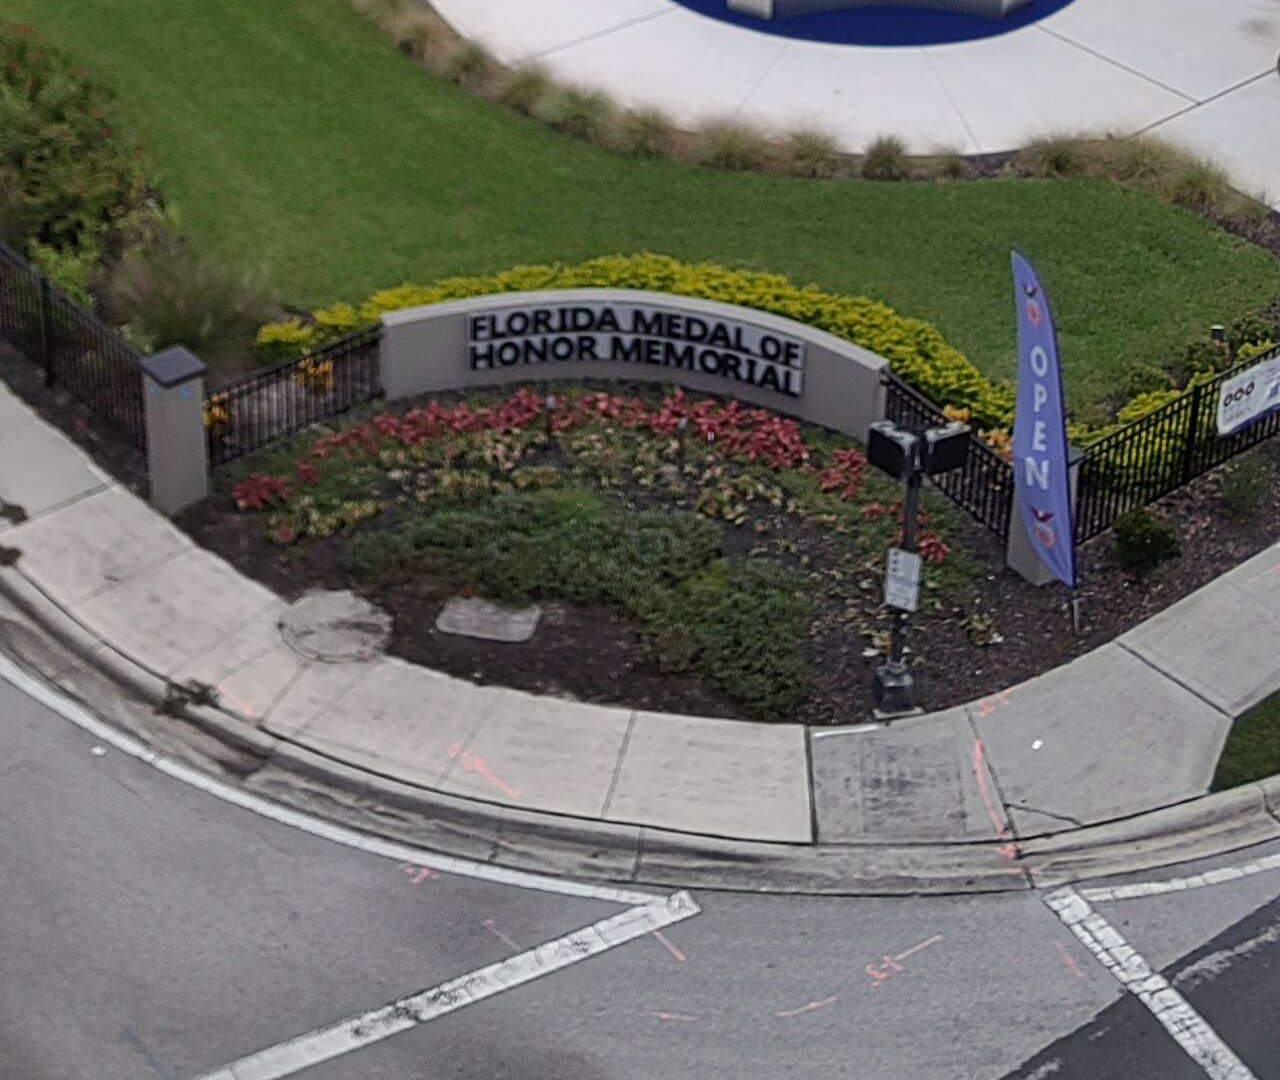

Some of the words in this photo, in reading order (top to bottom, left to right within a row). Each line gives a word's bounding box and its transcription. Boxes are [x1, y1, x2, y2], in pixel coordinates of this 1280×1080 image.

[471, 307, 621, 341] FLORIDA
[632, 309, 751, 354] MEDAL
[760, 335, 801, 367] OF
[471, 335, 599, 370] HONOR
[611, 336, 801, 398] MEMORIAL
[1024, 345, 1050, 490] OPEN
